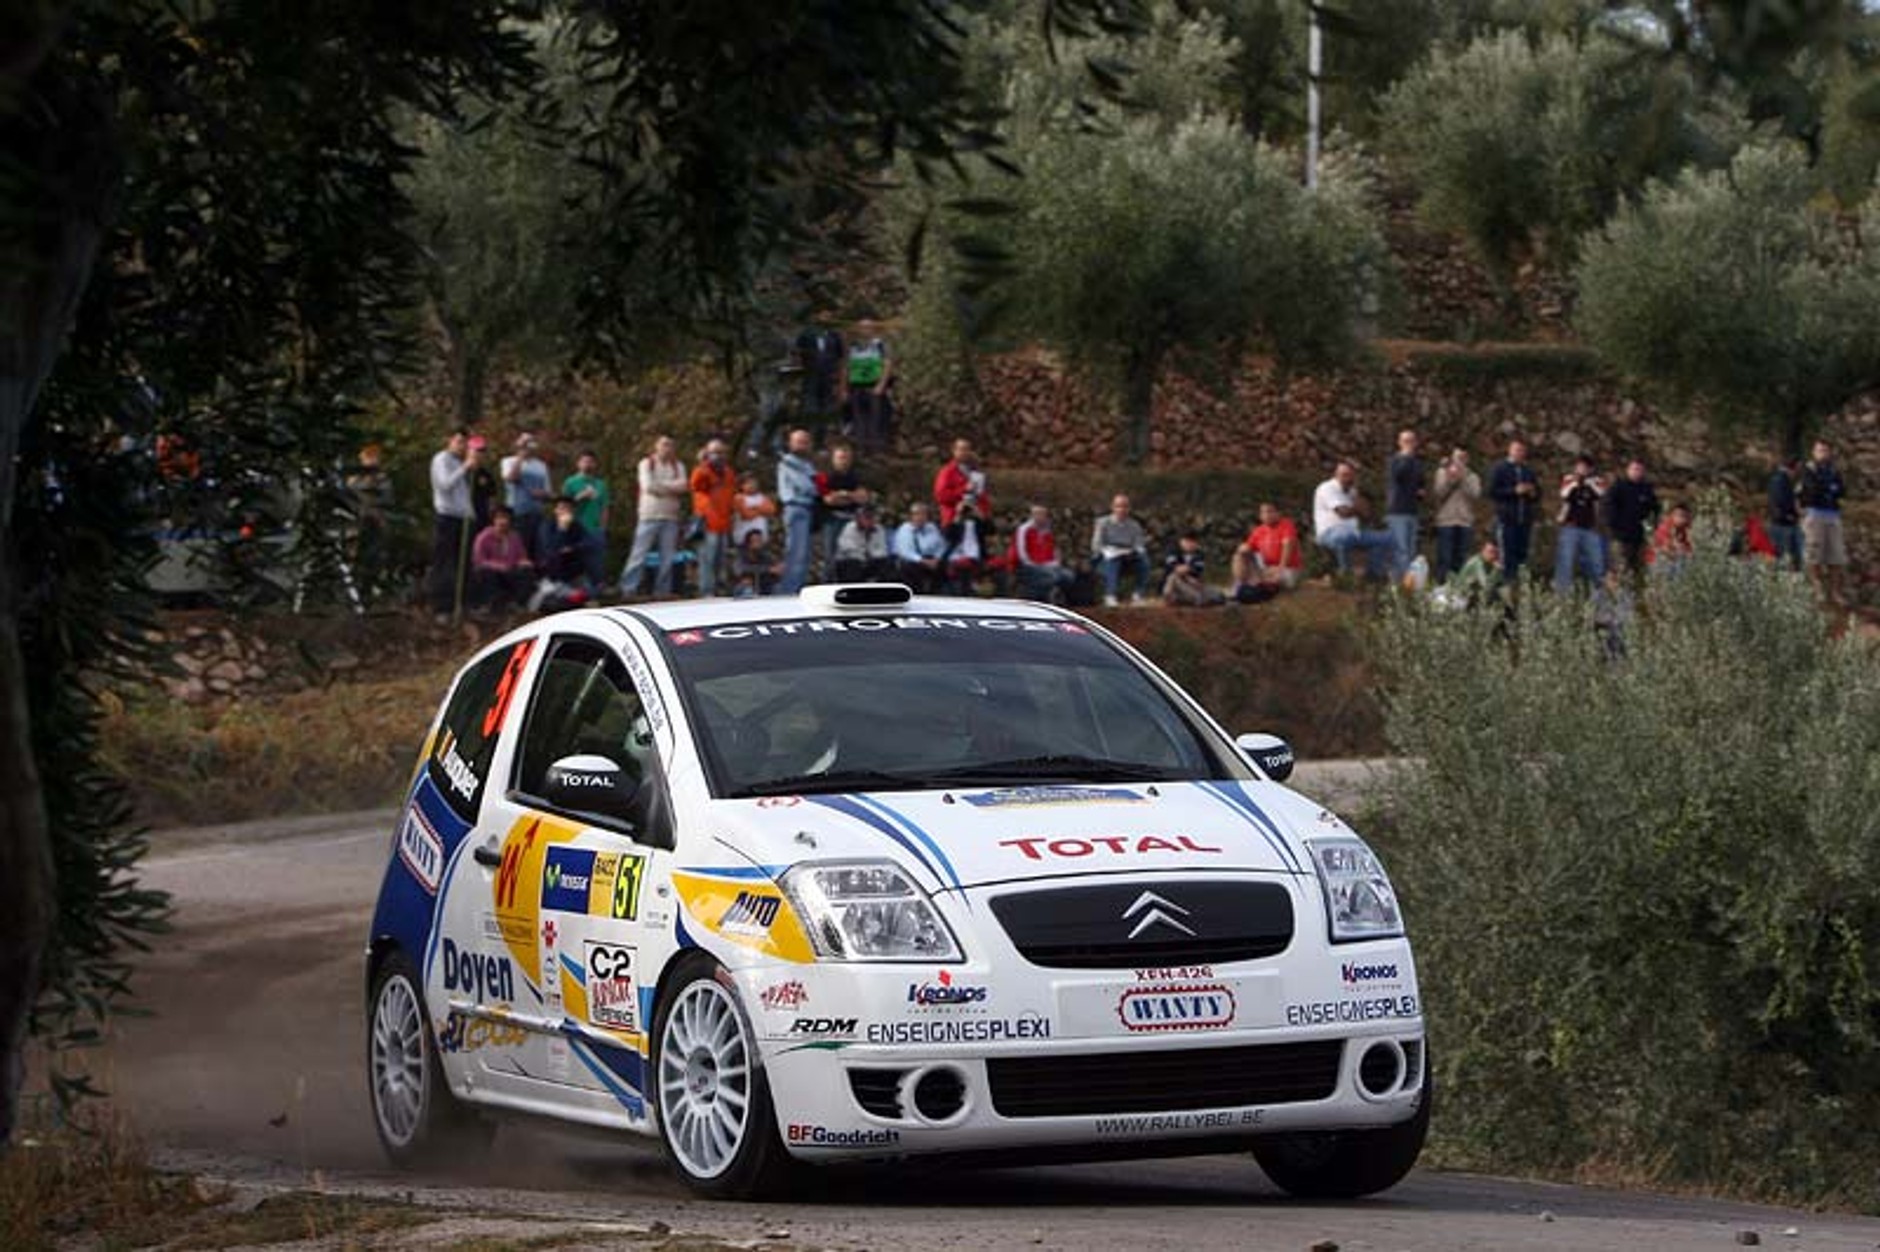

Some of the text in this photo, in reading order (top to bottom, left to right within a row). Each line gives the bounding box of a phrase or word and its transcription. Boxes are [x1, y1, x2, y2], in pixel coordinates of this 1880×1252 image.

[561, 772, 615, 788] TOTAL
[999, 836, 1222, 860] TOTAL
[615, 857, 643, 918] 51
[443, 938, 513, 1003] Doyen
[590, 947, 630, 981] C2
[1132, 996, 1221, 1019] WANTY
[790, 1019, 858, 1032] RDM
[867, 1018, 1050, 1043] ENSEIGNESPLEXI
[788, 1125, 900, 1143] BFGoodrich
